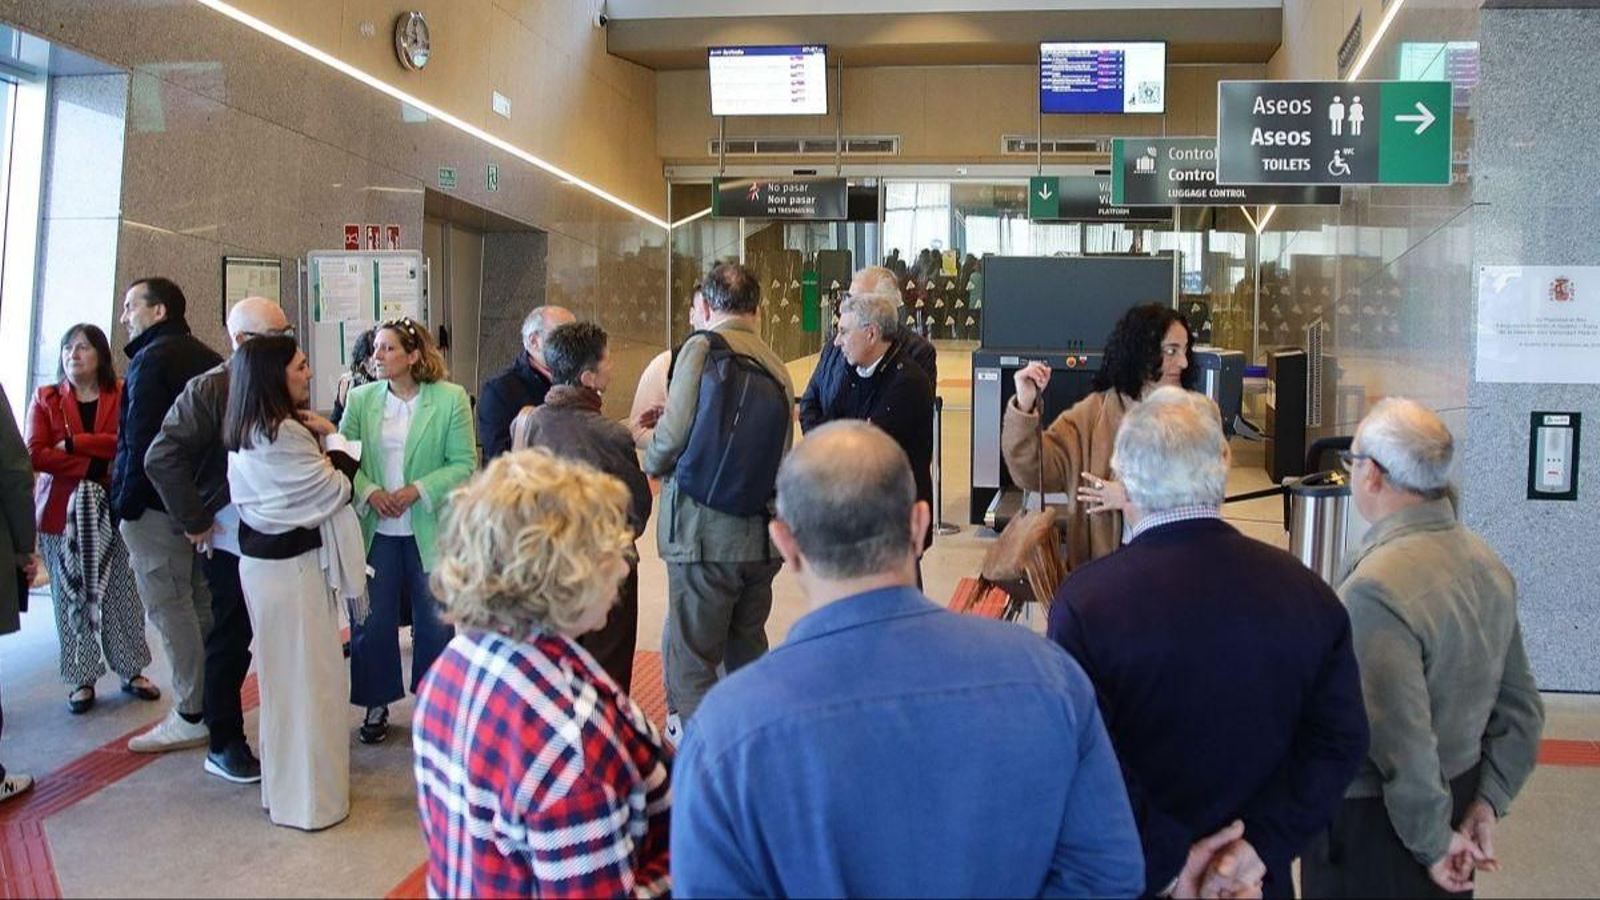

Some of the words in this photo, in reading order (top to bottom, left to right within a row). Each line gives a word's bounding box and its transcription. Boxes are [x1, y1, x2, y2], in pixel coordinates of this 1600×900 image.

[1252, 95, 1312, 115] Aseos
[1250, 127, 1311, 146] Aseos
[1262, 158, 1311, 171] TOILETS
[1168, 168, 1215, 181] Contro
[768, 183, 780, 192] No
[783, 184, 808, 194] pasar
[1168, 189, 1207, 198] LUGGAGE
[1209, 189, 1246, 198] CONTROL
[768, 195, 786, 204] Non
[790, 196, 816, 206] pasar
[5, 781, 14, 793] N
